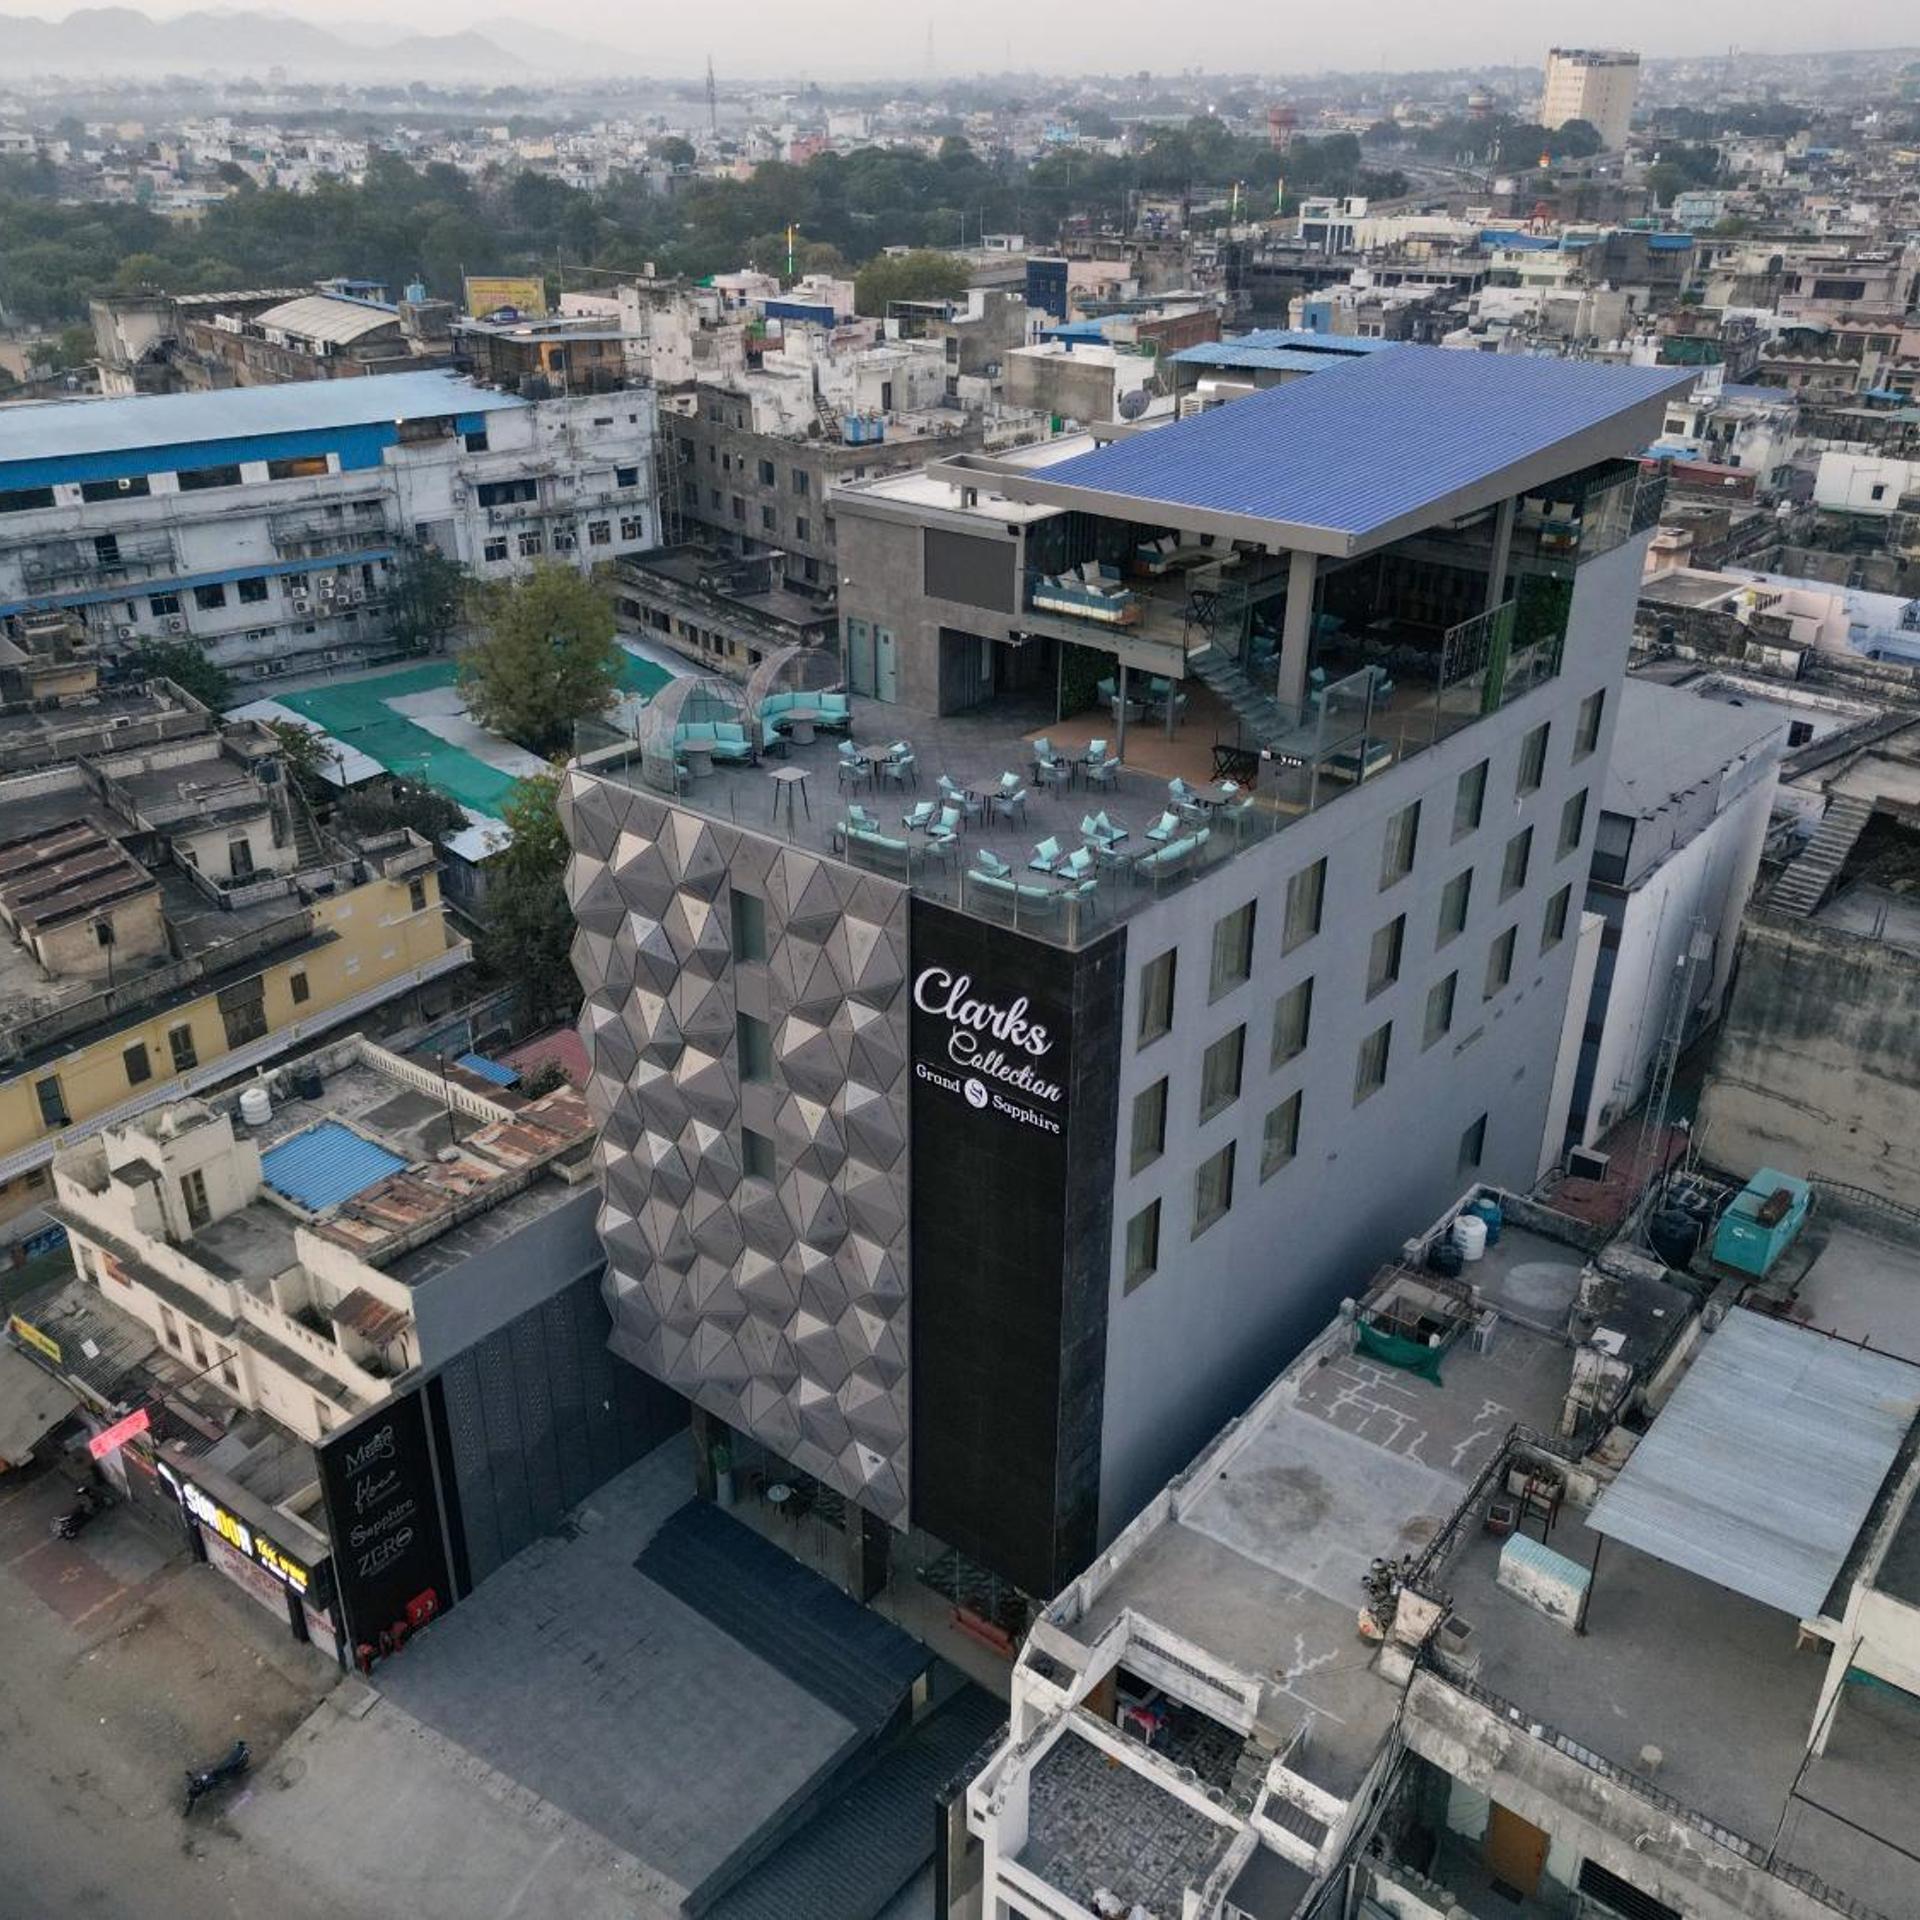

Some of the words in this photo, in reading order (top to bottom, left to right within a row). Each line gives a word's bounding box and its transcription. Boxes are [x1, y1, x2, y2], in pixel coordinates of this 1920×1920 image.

[914, 967, 1053, 1055] Clarks
[916, 1063, 961, 1094] Grand
[992, 1094, 1060, 1135] Sapphire
[948, 1025, 1062, 1102] Collection
[350, 1499, 414, 1547] Sapphire
[358, 1527, 414, 1576] ZERO
